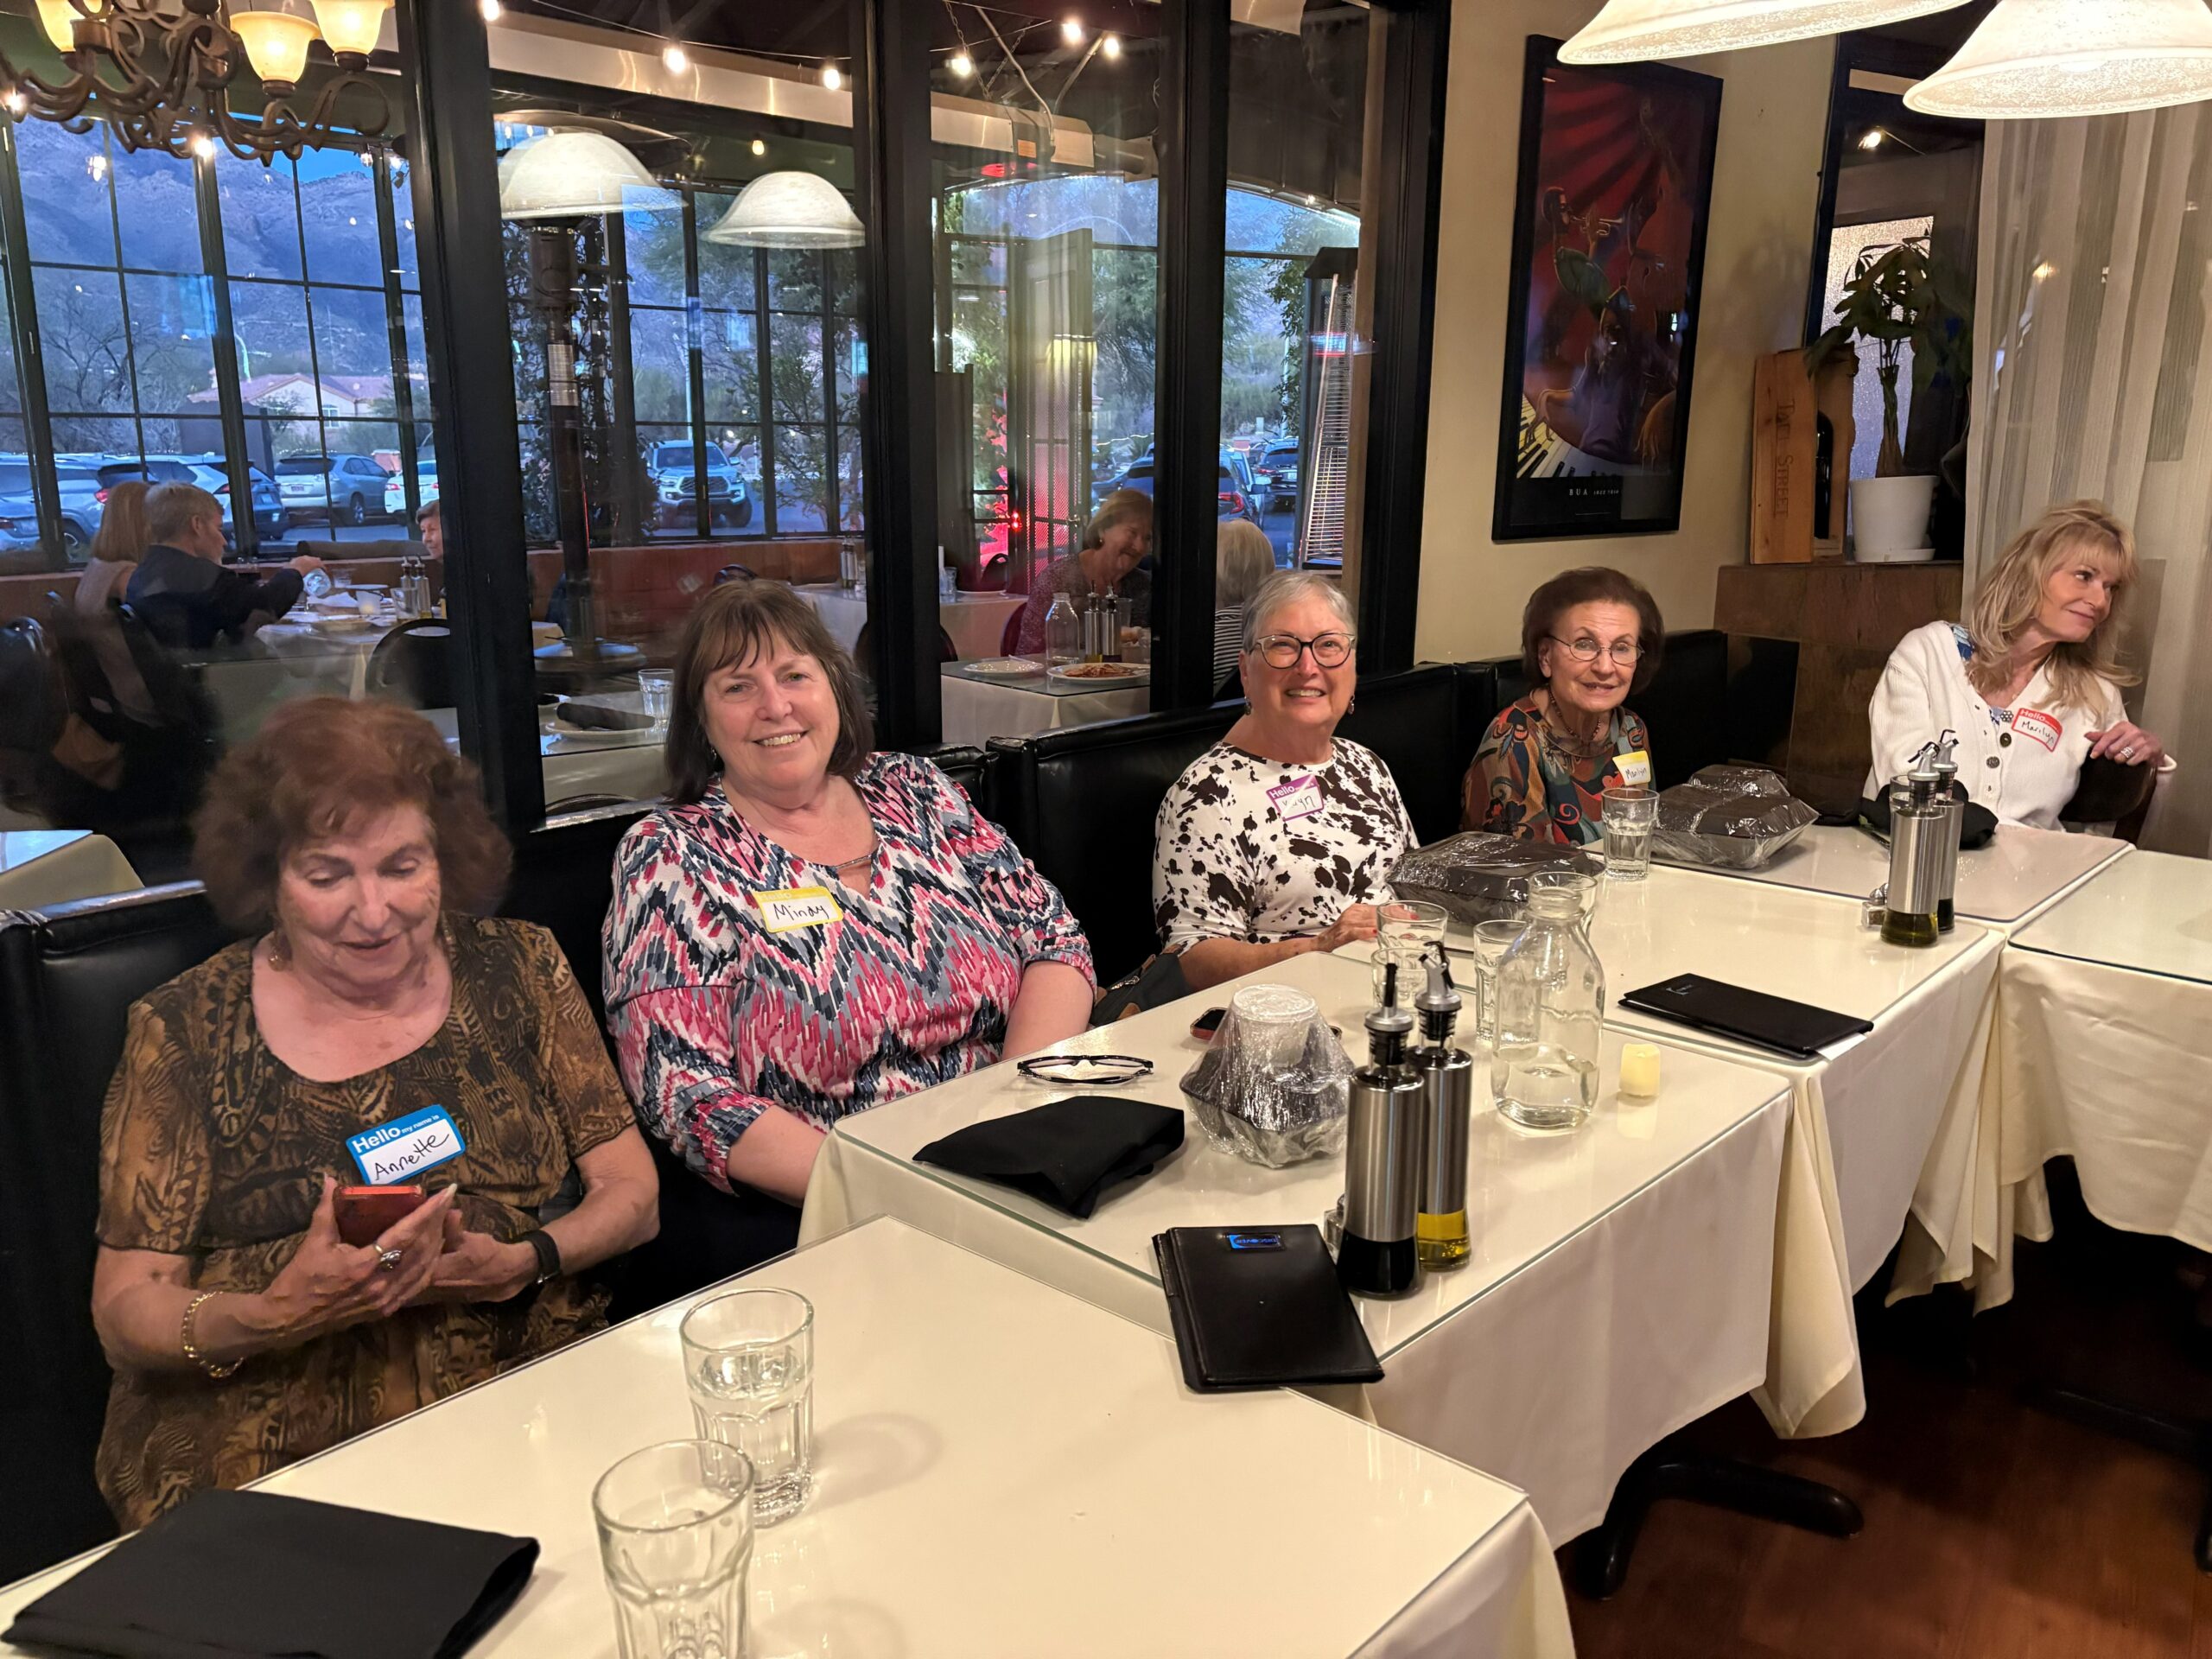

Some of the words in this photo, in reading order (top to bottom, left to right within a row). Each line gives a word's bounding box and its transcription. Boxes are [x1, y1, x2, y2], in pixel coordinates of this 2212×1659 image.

[1776, 454, 1795, 518] STREET
[2020, 709, 2046, 721] Hello
[2022, 721, 2054, 743] Marilyn
[1268, 785, 1295, 798] Hello
[773, 903, 830, 921] Mindy
[352, 1127, 401, 1153] Hello
[413, 1117, 432, 1128] name
[375, 1134, 449, 1180] Annette
